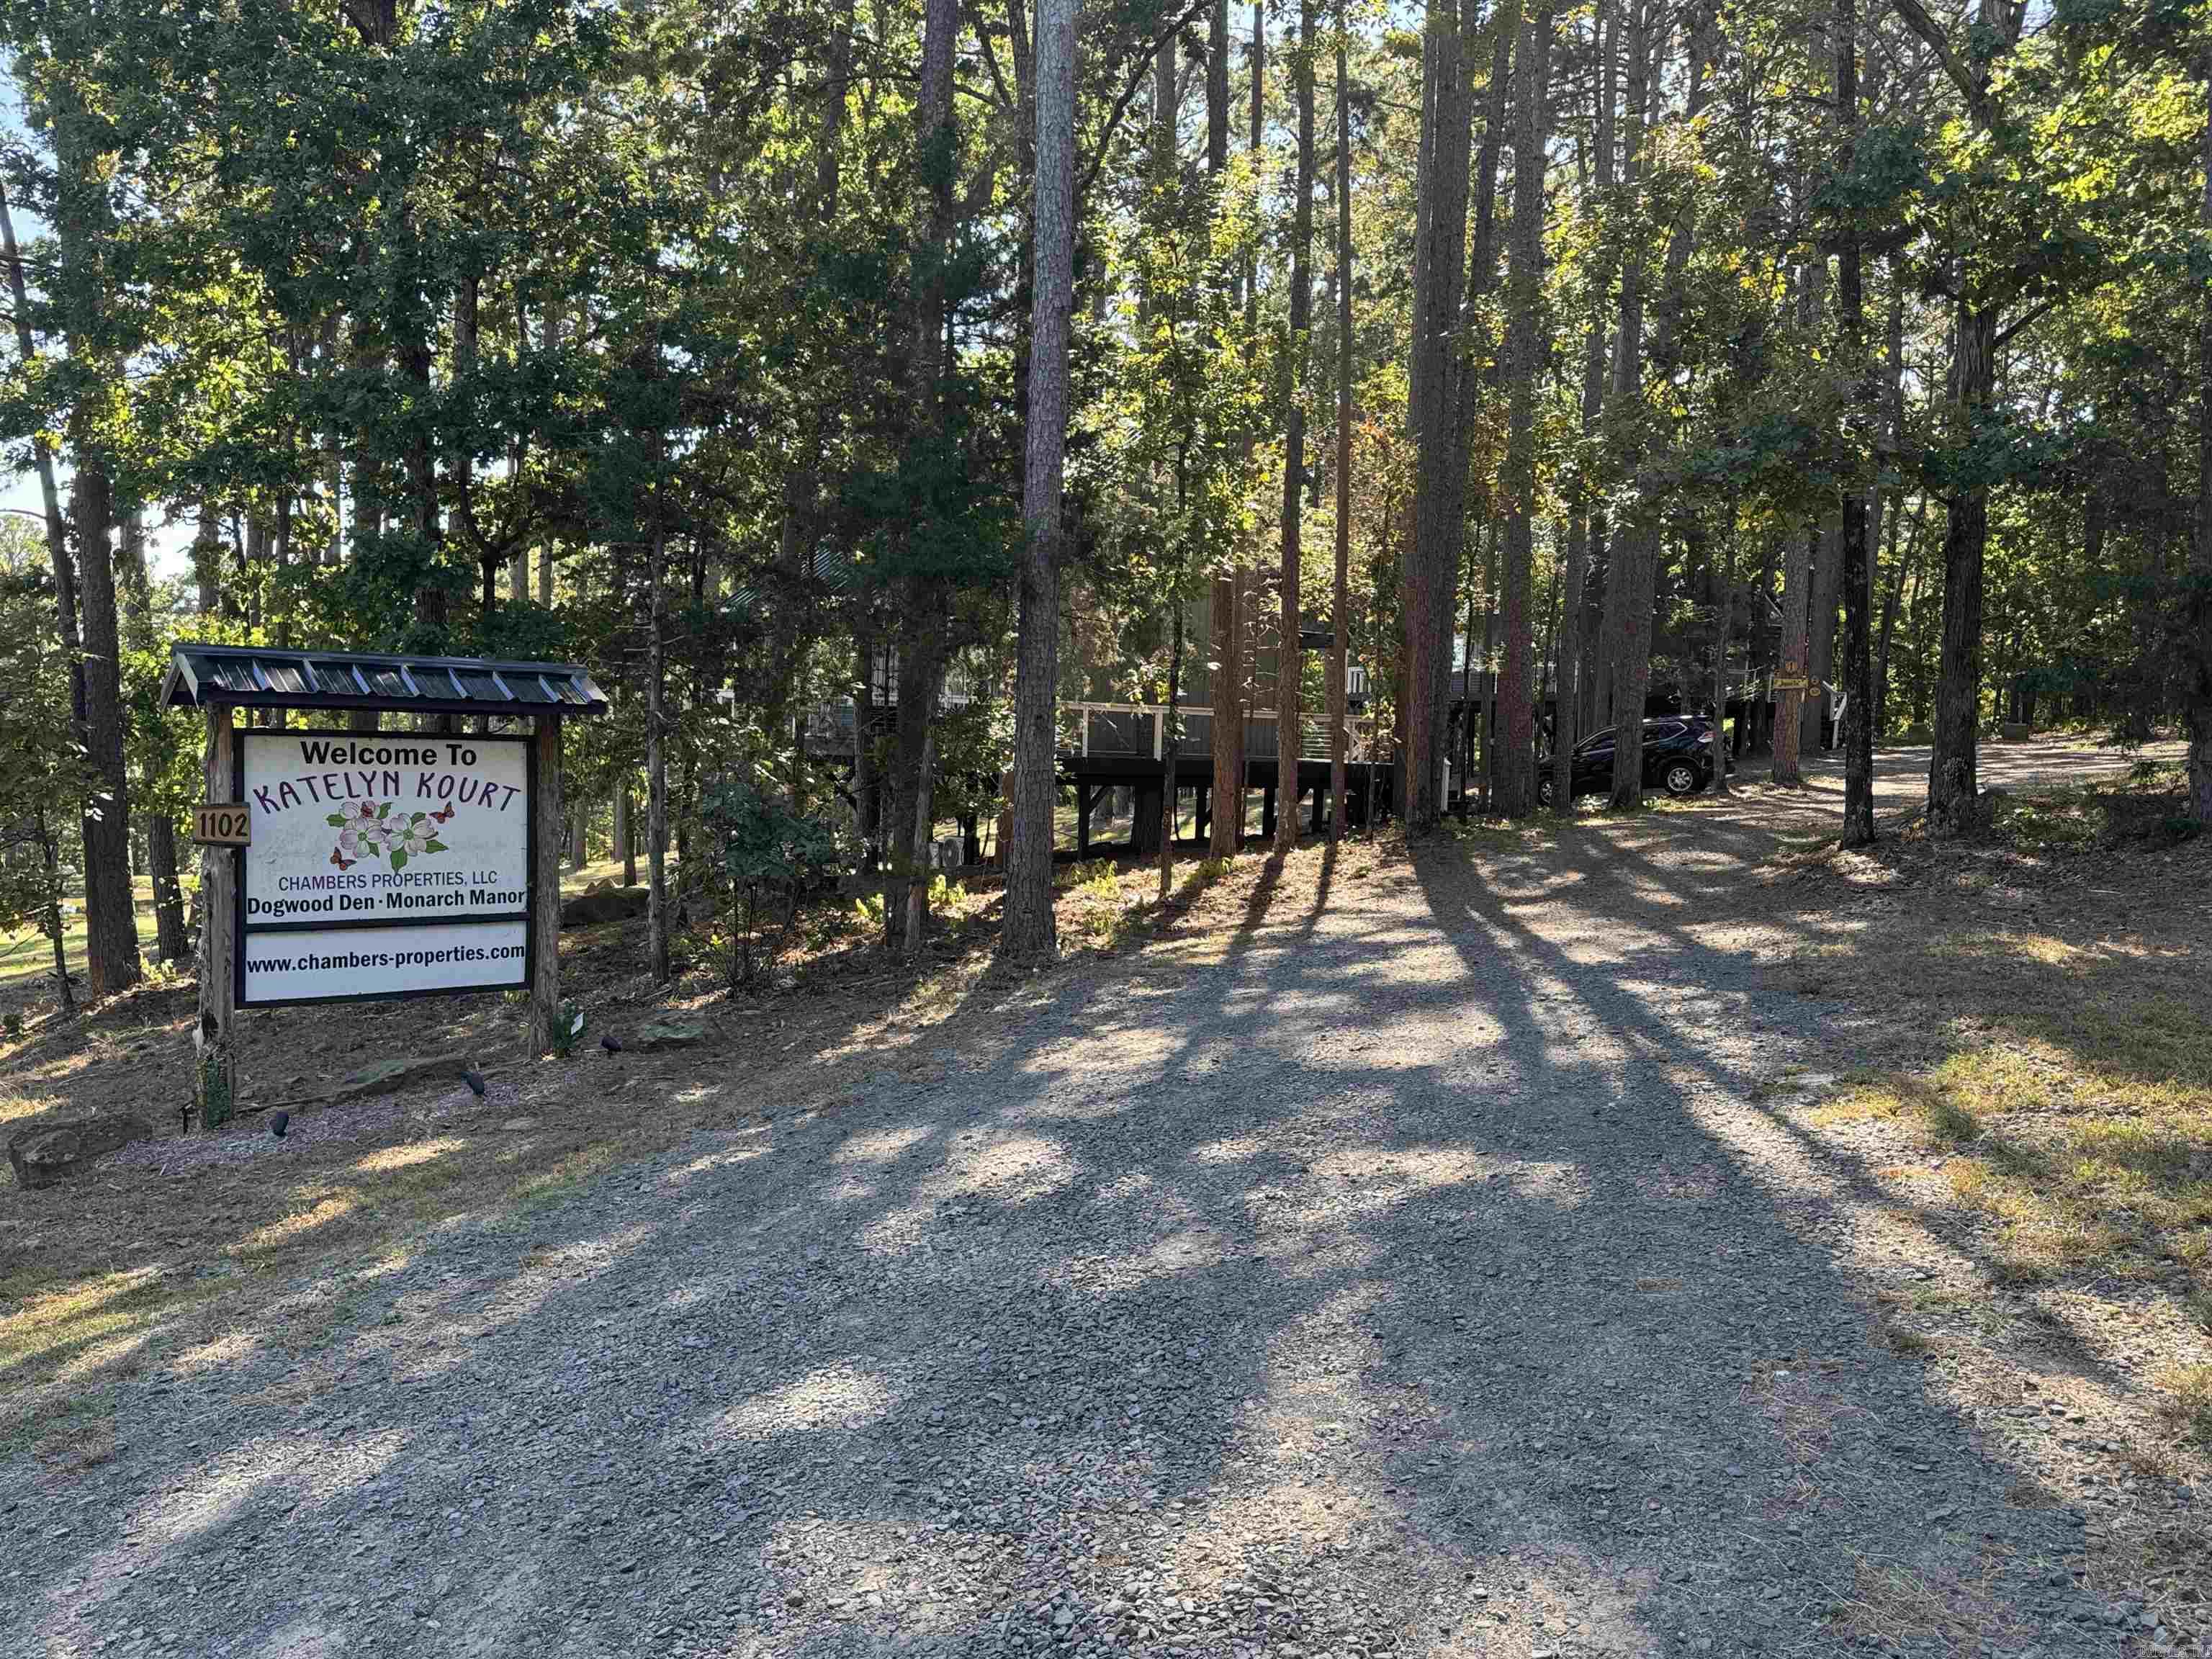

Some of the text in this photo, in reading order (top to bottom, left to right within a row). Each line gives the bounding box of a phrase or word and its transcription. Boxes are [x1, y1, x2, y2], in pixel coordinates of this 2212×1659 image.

[301, 742, 477, 765] Welcome To
[253, 770, 521, 814] KATELYN KOURT
[199, 813, 248, 837] 1102
[279, 871, 498, 891] CHAMBERS PROPERTIES, LLC
[248, 889, 525, 918] Dogwood Den Monarch Manor
[247, 944, 525, 973] www.chambers-properties.com
